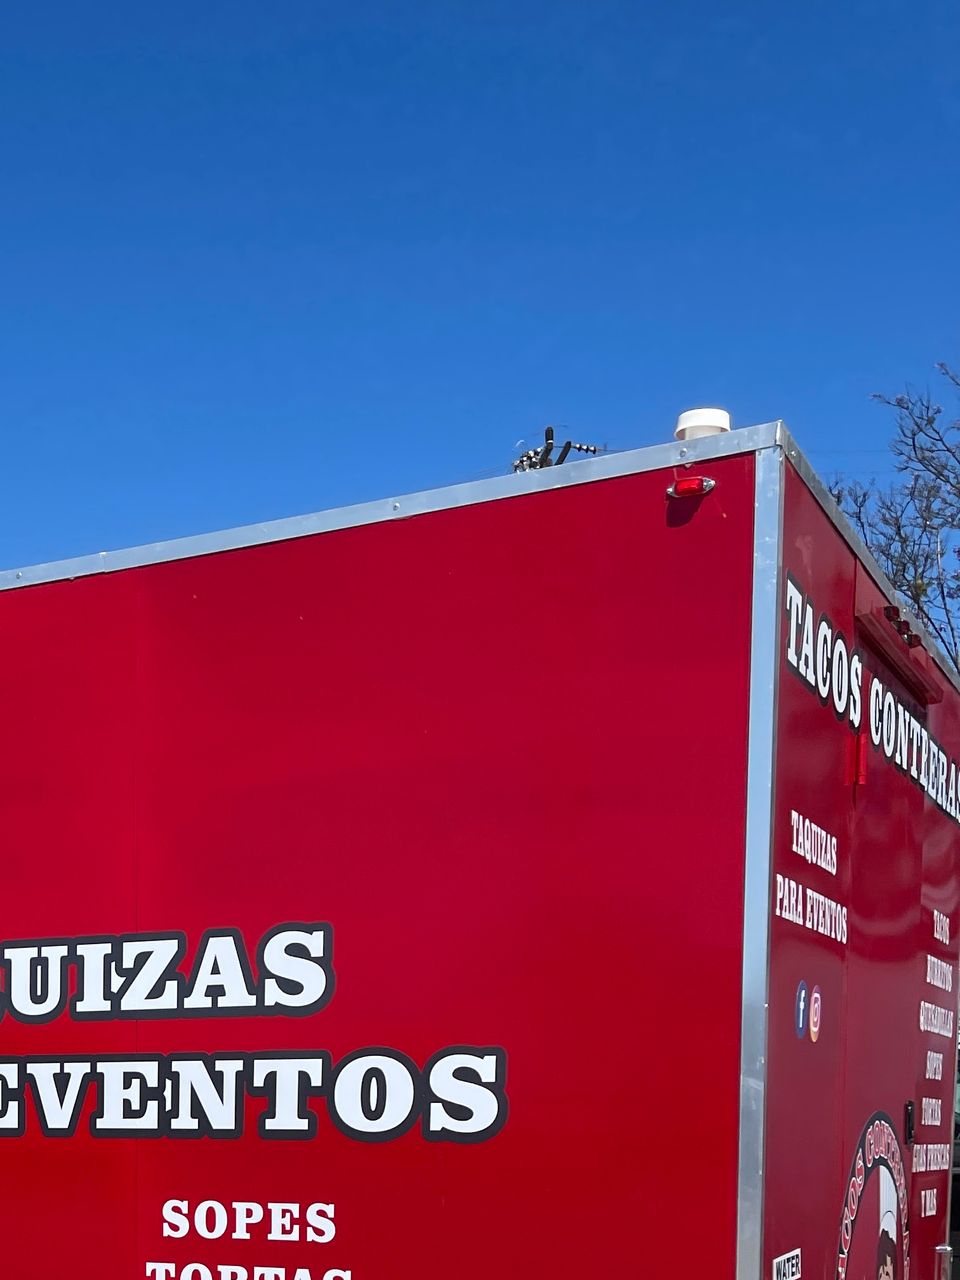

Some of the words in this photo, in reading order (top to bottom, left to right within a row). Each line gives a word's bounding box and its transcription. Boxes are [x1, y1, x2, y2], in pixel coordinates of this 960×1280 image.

[786, 579, 862, 728] TACOS
[870, 678, 960, 823] CONTRERA
[791, 810, 837, 876] TAQUIZAS
[776, 873, 804, 926] PARA
[806, 888, 847, 944] EVENTOS
[162, 1199, 336, 1243] SOPES
